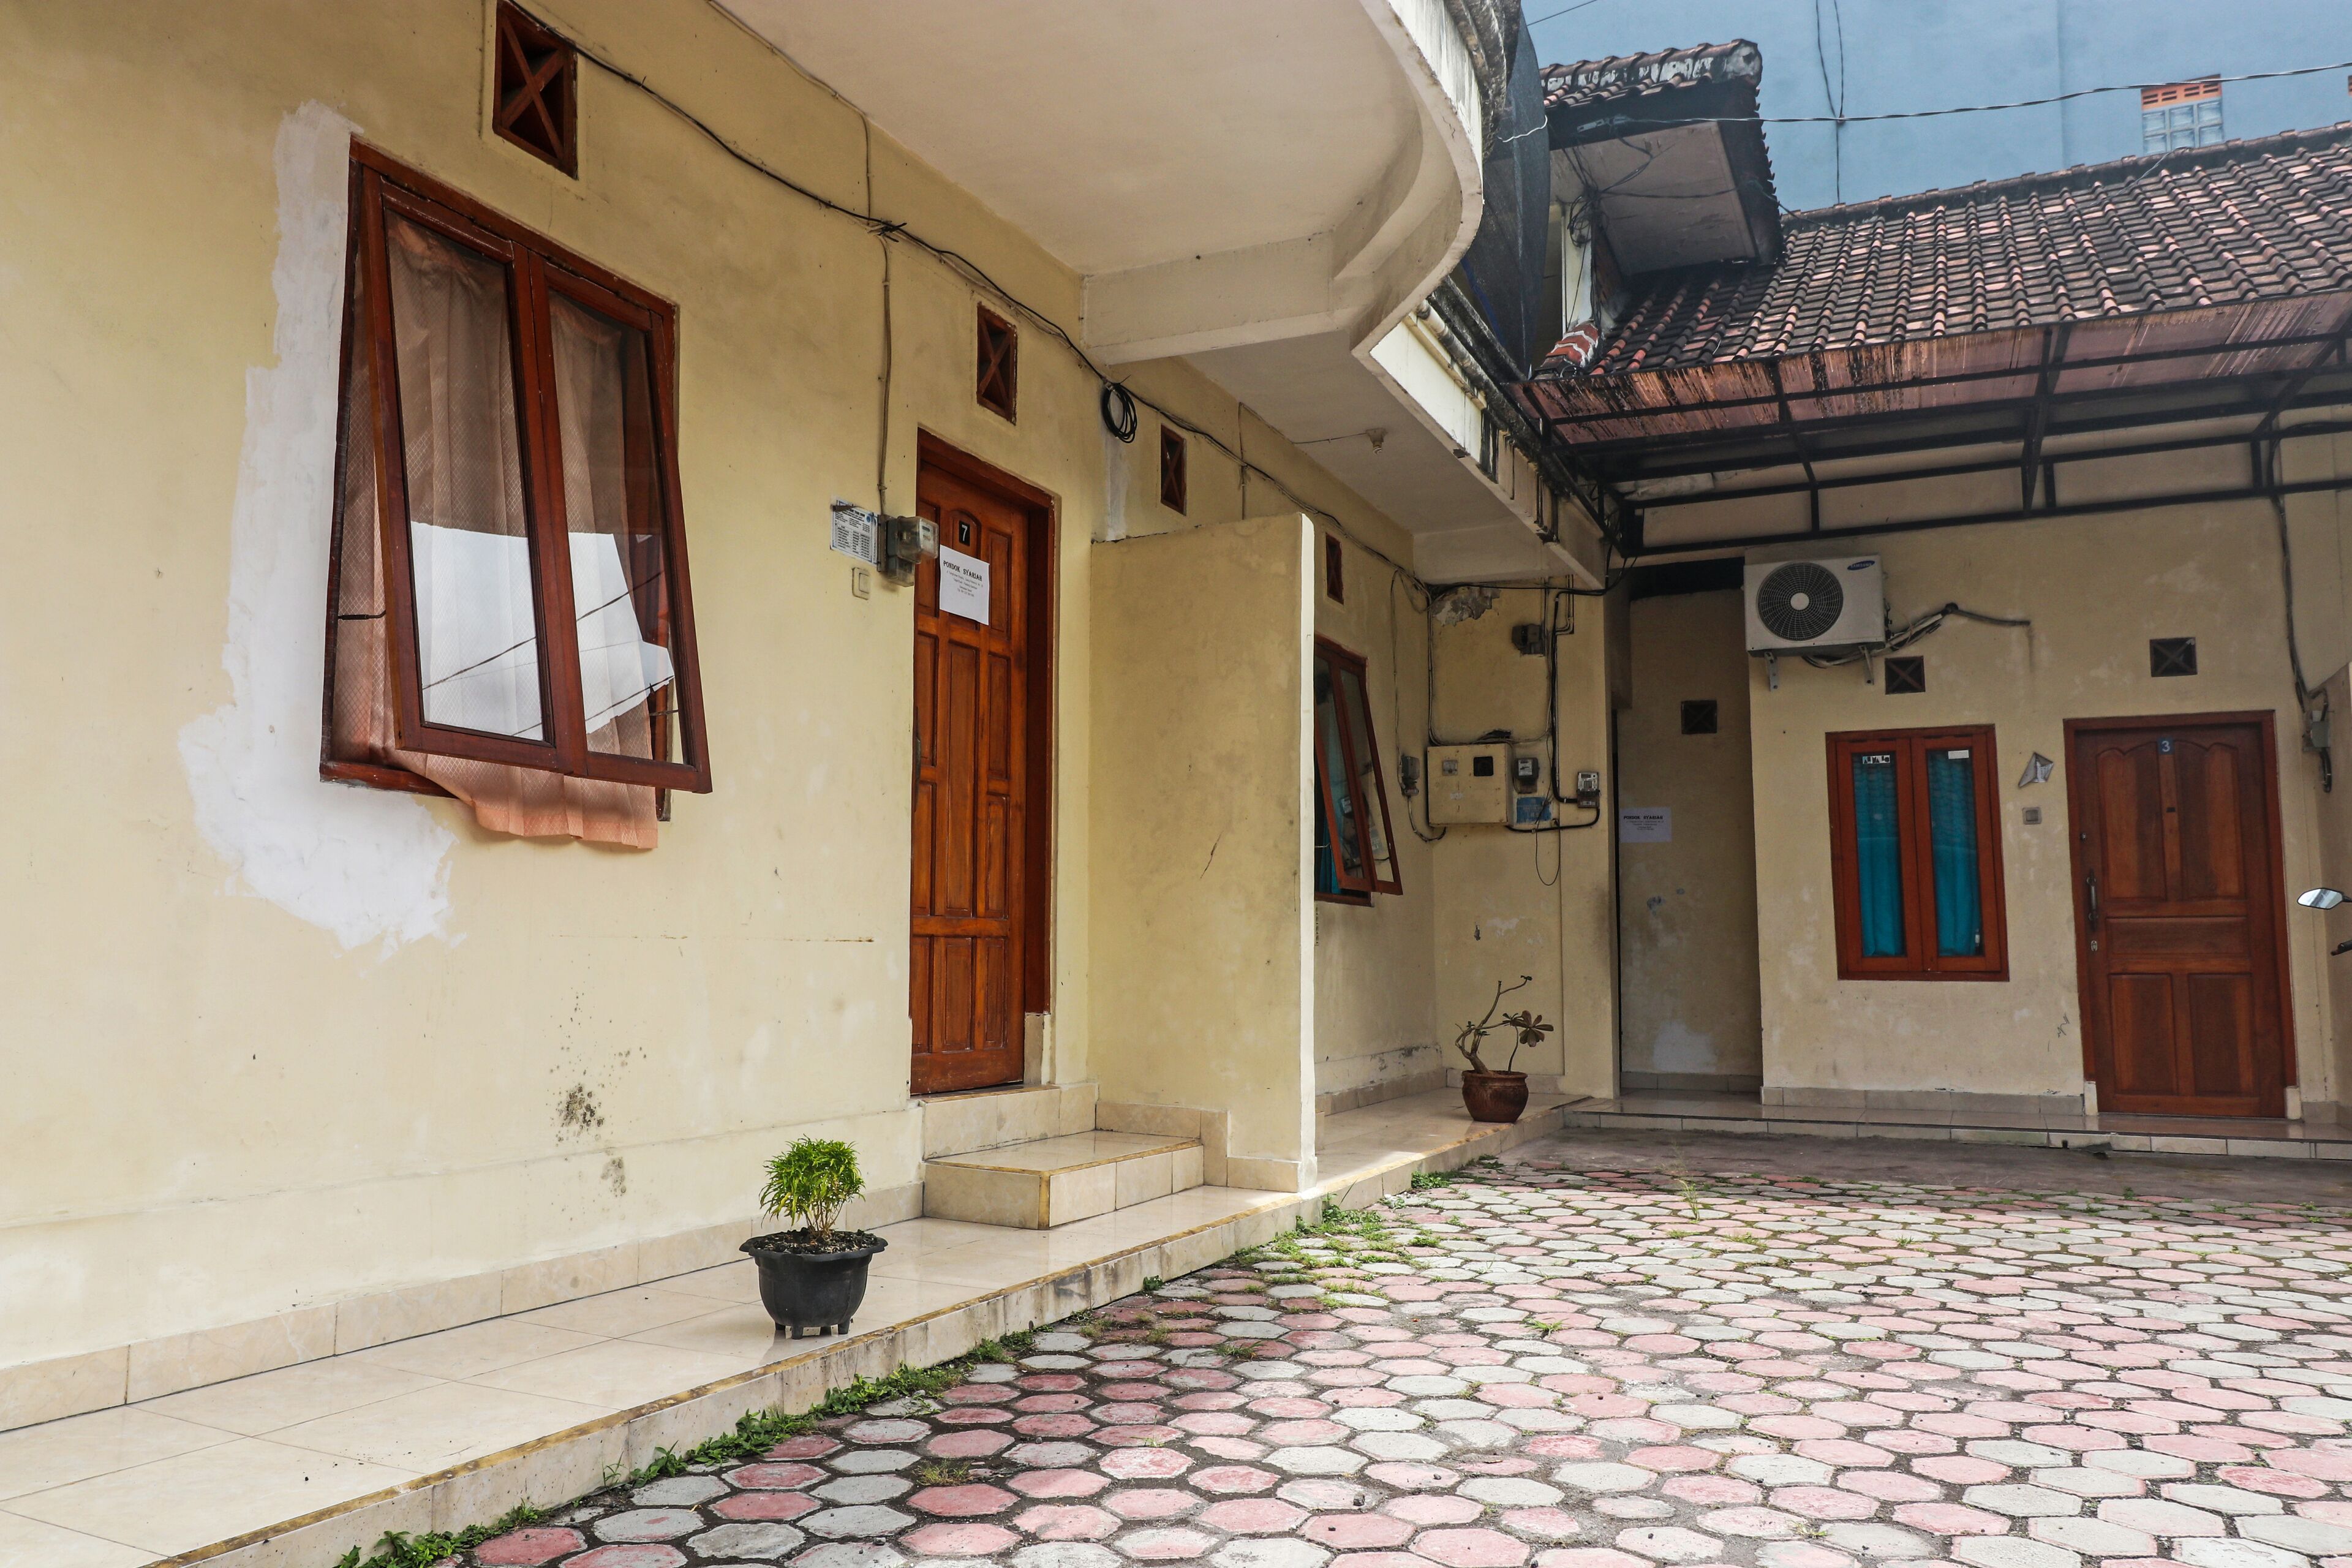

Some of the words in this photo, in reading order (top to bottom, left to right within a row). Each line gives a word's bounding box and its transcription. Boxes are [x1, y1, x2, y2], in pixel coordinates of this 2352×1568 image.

[961, 524, 968, 542] 7
[943, 560, 960, 573] PONDOK
[963, 568, 982, 581] SYARIAH
[2162, 741, 2170, 752] 3
